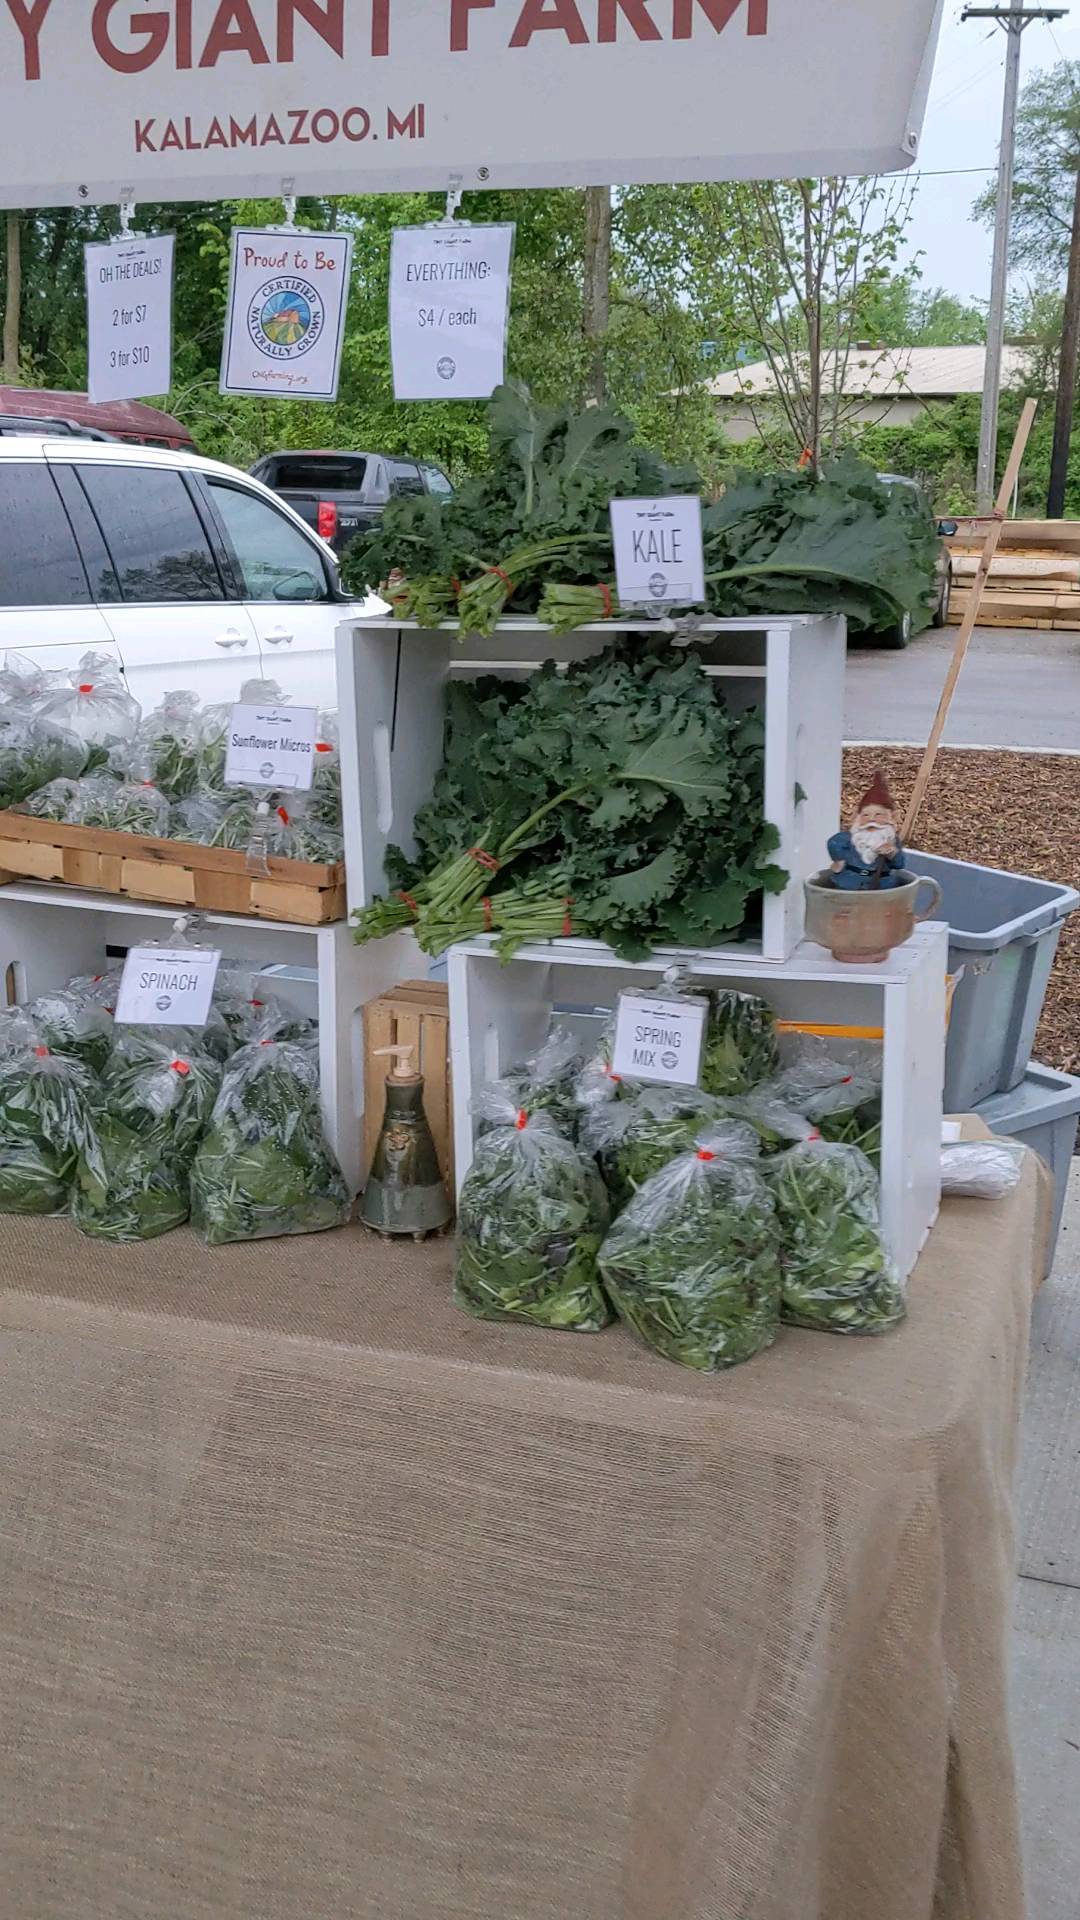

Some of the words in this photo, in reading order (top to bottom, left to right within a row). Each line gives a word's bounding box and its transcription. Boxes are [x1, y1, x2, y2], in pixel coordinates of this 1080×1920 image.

[387, 103, 425, 140] MI
[100, 267, 113, 283] OH
[115, 263, 131, 280] THE
[133, 257, 161, 278] DEALS!
[243, 247, 288, 268] Proud
[294, 250, 308, 270] to
[314, 251, 336, 271] Be
[406, 261, 491, 281] EVERYTHING:
[262, 279, 317, 303] CERTIFIED
[112, 309, 119, 326] 2
[121, 308, 133, 325] for
[135, 304, 147, 323] $7
[438, 308, 446, 326] /
[448, 307, 477, 326] each
[250, 306, 293, 357] NATURALLY
[297, 311, 321, 351] GROWN
[110, 350, 116, 368] 3
[118, 350, 130, 367] for
[132, 345, 150, 365] $10
[632, 529, 683, 563] KALE
[231, 733, 278, 750] Sunflower
[280, 736, 311, 753] Micros
[140, 972, 198, 991] SPINACH
[634, 1025, 682, 1048] SPRING
[632, 1048, 656, 1067] MIX
